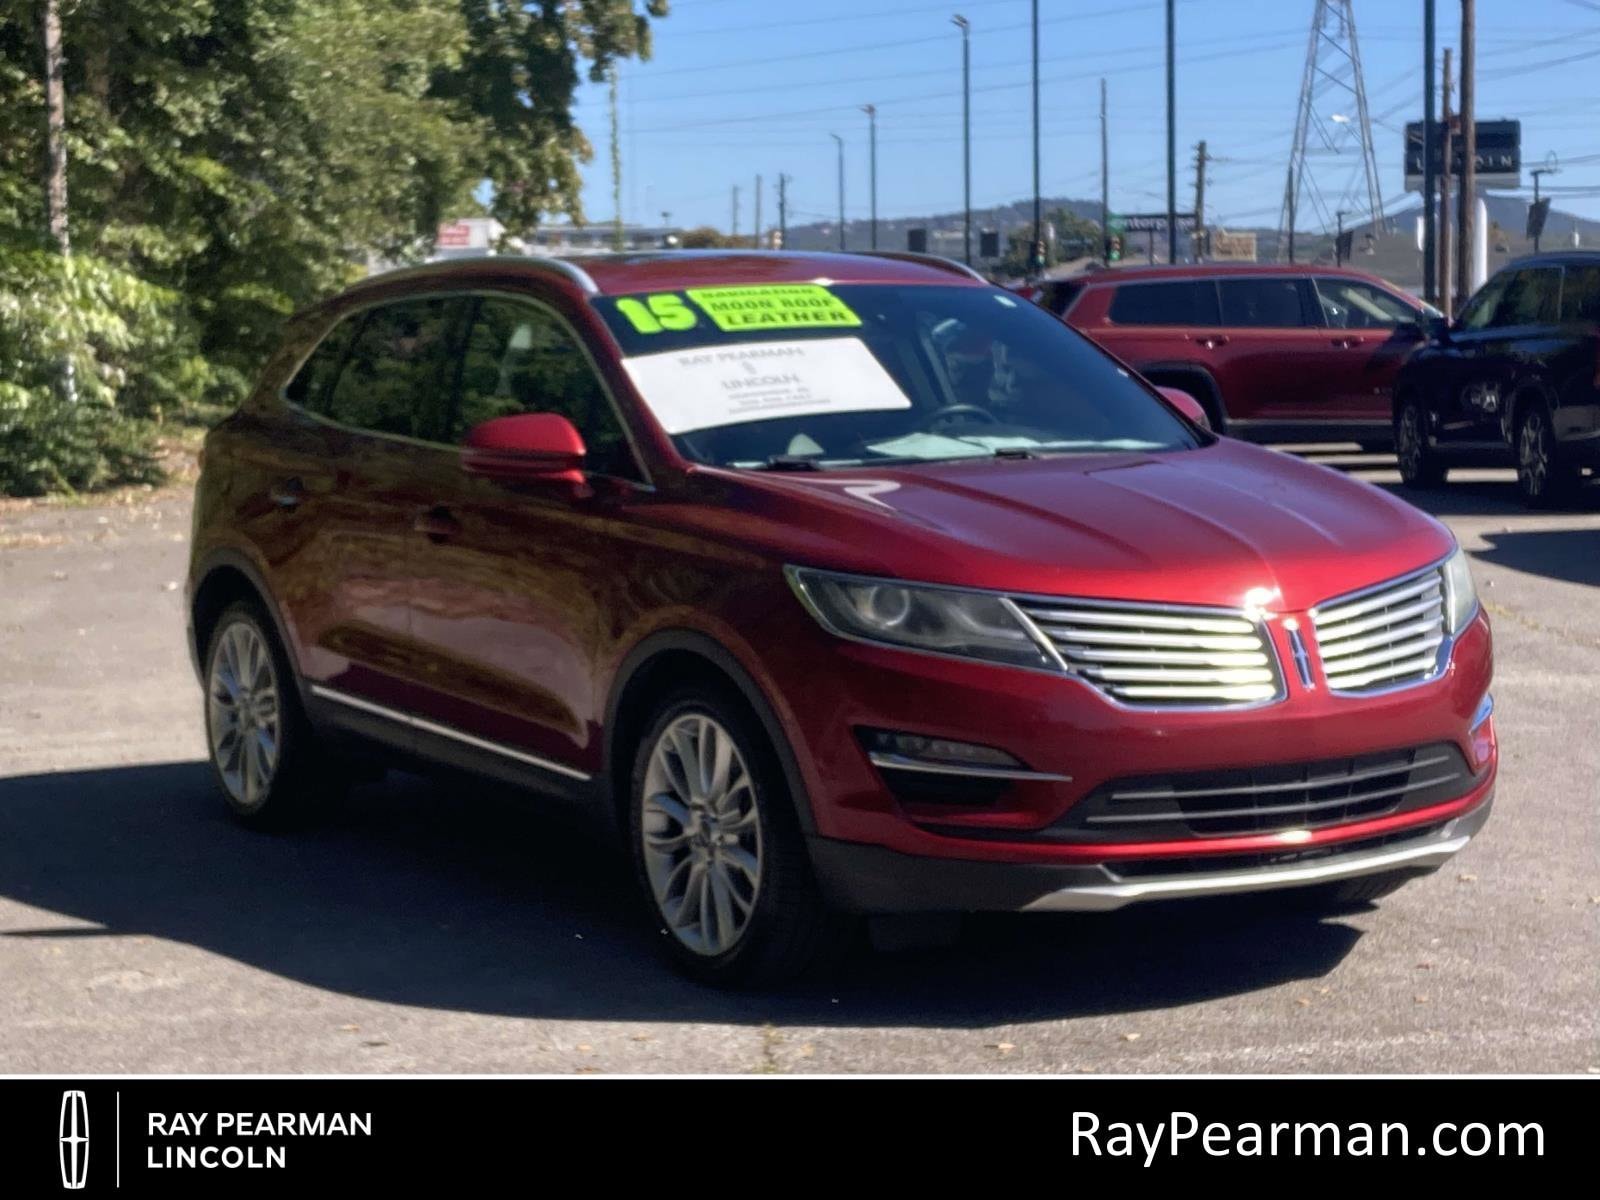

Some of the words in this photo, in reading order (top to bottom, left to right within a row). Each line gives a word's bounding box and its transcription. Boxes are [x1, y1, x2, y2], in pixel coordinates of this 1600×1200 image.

[711, 299, 775, 312] MOON
[780, 297, 833, 308] ROOF
[616, 294, 698, 333] 15
[726, 311, 848, 326] LEATHER
